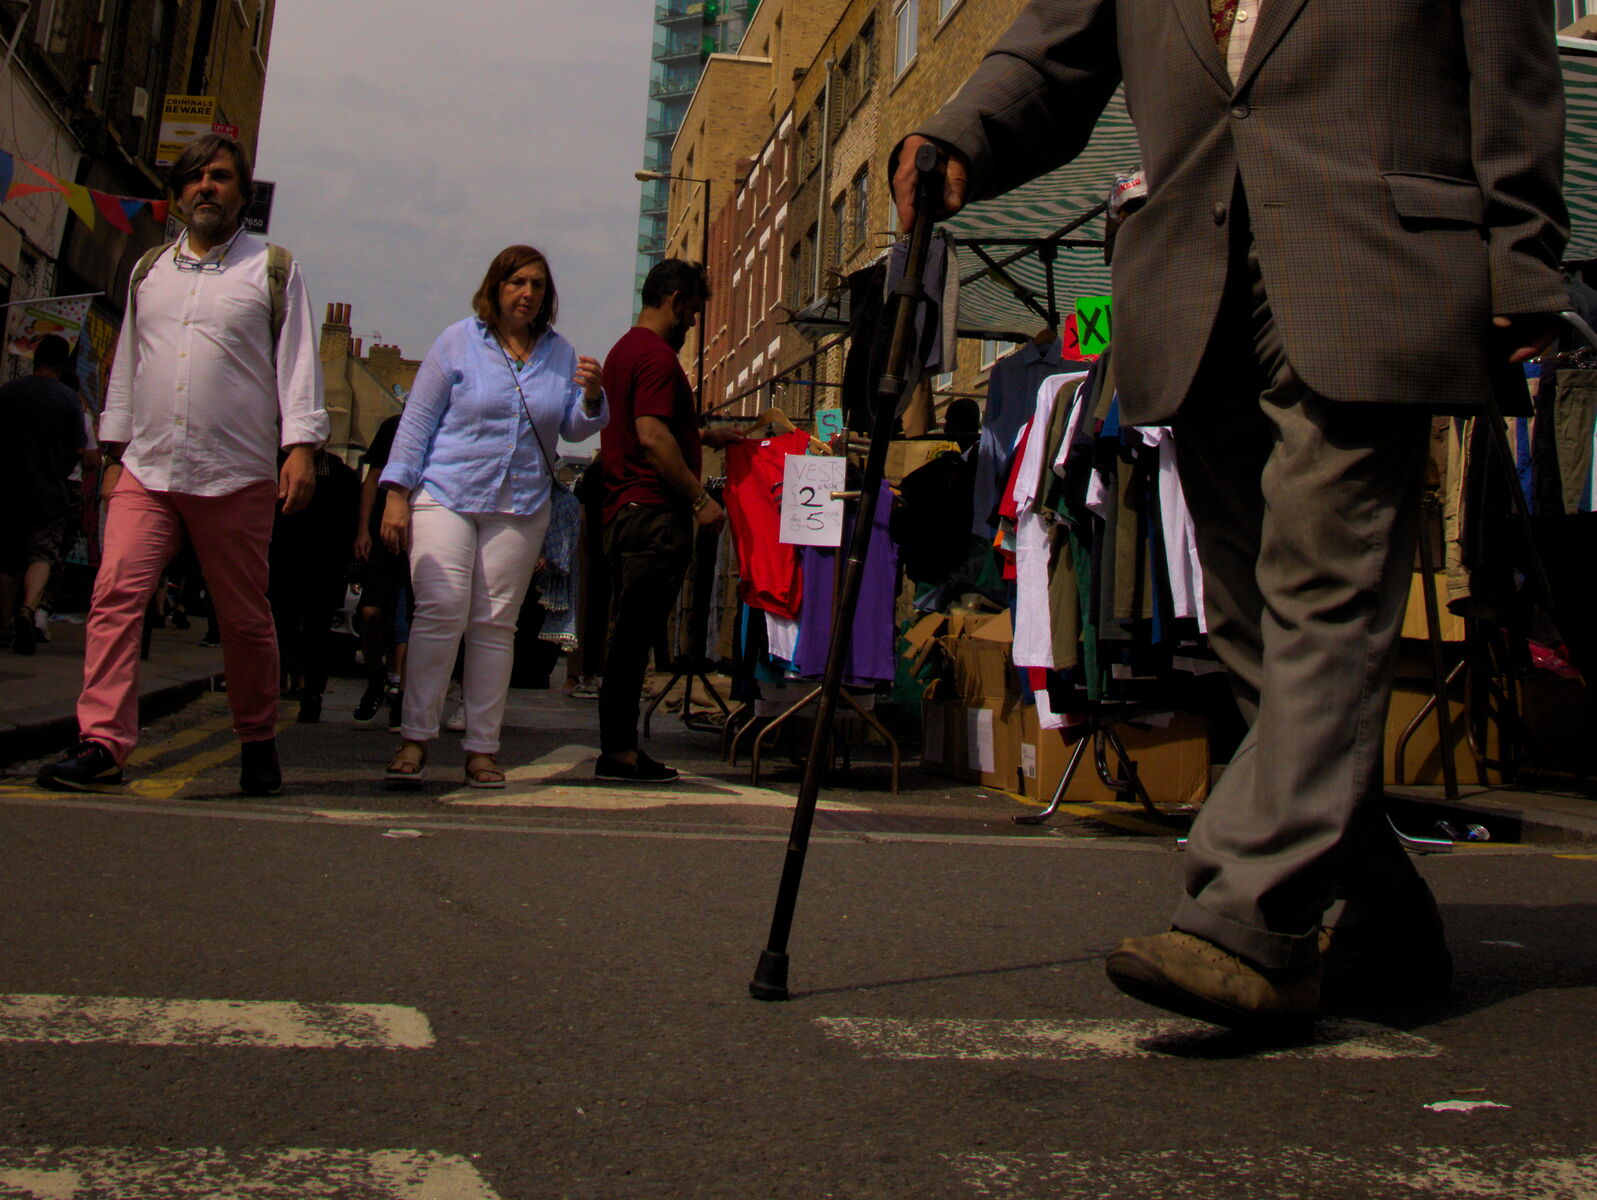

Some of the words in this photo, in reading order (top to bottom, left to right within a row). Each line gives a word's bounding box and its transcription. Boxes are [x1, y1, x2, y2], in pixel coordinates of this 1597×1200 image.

[166, 98, 213, 107] CRIMINALS
[165, 106, 212, 115] BEWARE
[822, 414, 838, 435] S
[793, 461, 845, 482] VESTS
